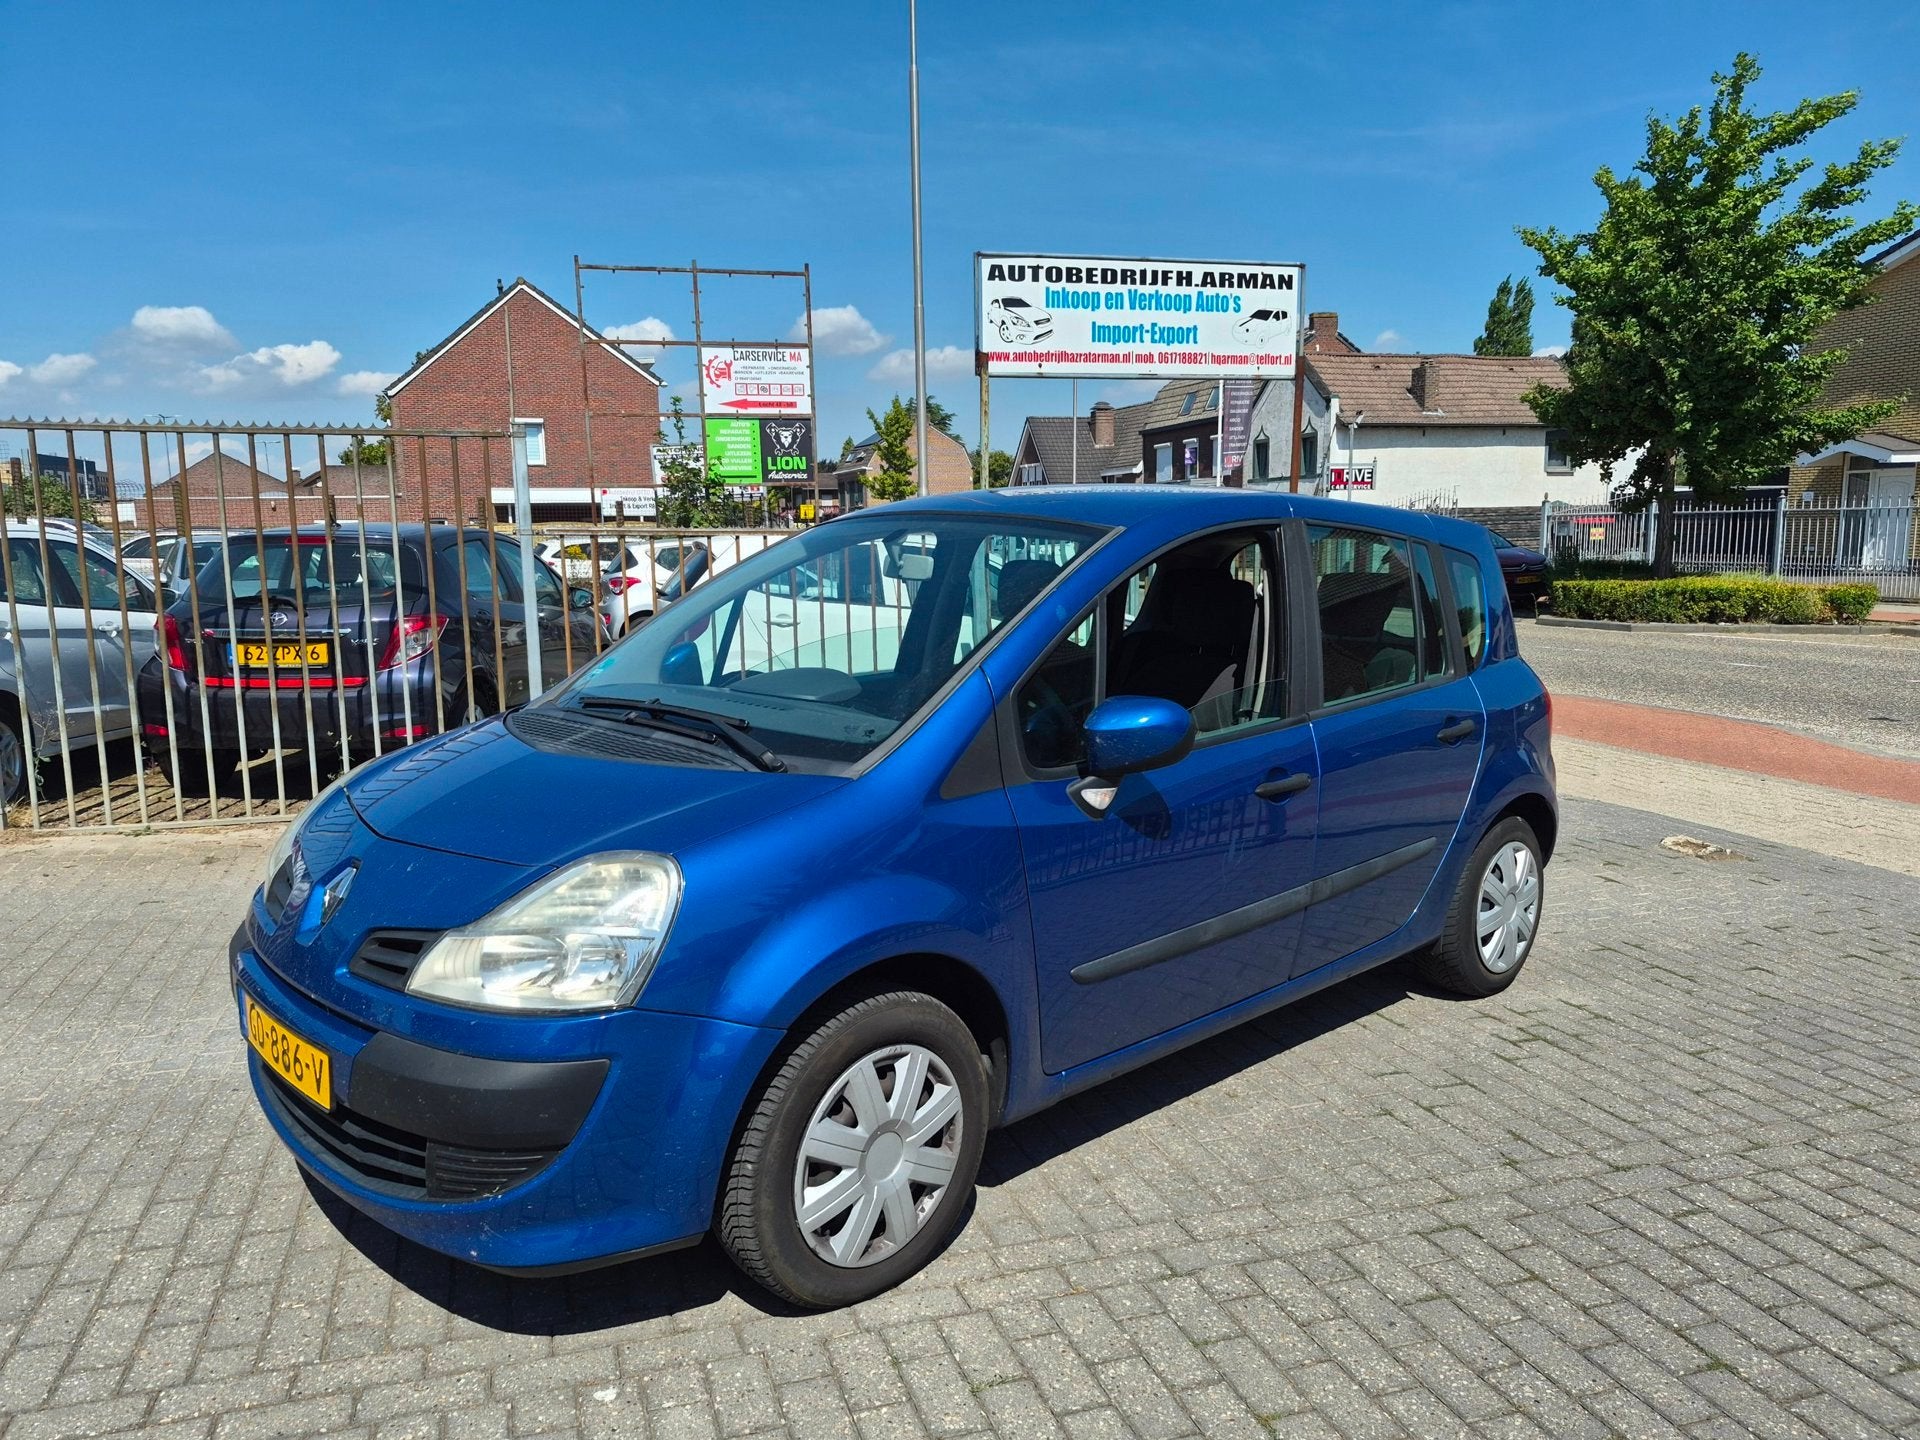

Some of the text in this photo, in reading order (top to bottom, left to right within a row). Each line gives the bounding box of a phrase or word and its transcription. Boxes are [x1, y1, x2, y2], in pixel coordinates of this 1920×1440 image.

[987, 263, 1294, 290] AUTOBEDRIJFH.ARMAN
[1045, 286, 1241, 313] Inkoop en Verkoop Auto's
[1091, 321, 1198, 346] Import-Export
[733, 350, 802, 362] CARSERVICE MA
[767, 456, 807, 470] LION
[768, 470, 808, 480] Autoservice
